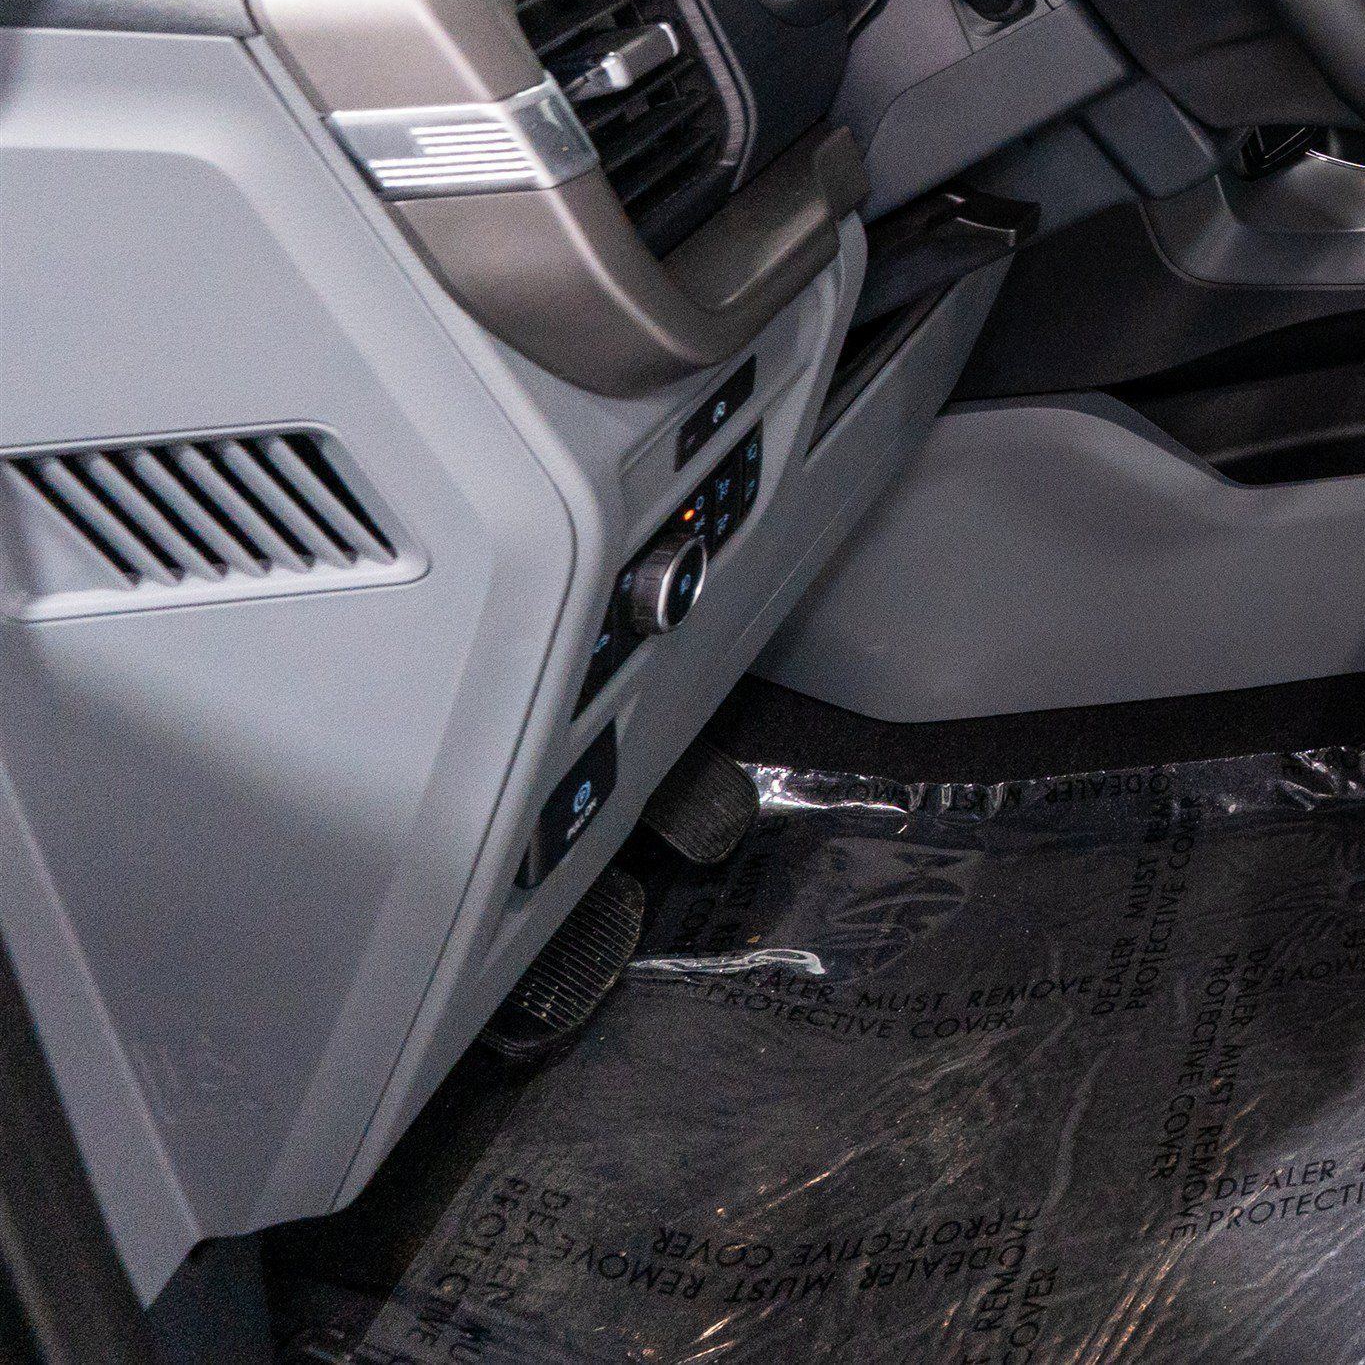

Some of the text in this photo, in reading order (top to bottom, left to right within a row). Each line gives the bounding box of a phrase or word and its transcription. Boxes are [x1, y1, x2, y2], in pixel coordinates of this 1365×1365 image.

[1045, 772, 1142, 803] DEALER
[1092, 859, 1158, 1016] DEALER MUST
[1125, 796, 1203, 1011] PROTECTIVE COVER
[706, 982, 1015, 1040] PROTECTIVE COVER
[743, 968, 1096, 1012] EALER MUST REMOVE
[1149, 952, 1239, 1182] PROTECTIVE COVER
[1169, 943, 1273, 1241] DEALER MUST REMOVE
[1214, 1159, 1338, 1201] DEALER
[548, 1234, 992, 1304] DEALER MUST REMOVE
[652, 1213, 1007, 1270] PROTECTIVE COVER
[973, 1206, 1041, 1333] REMOVE
